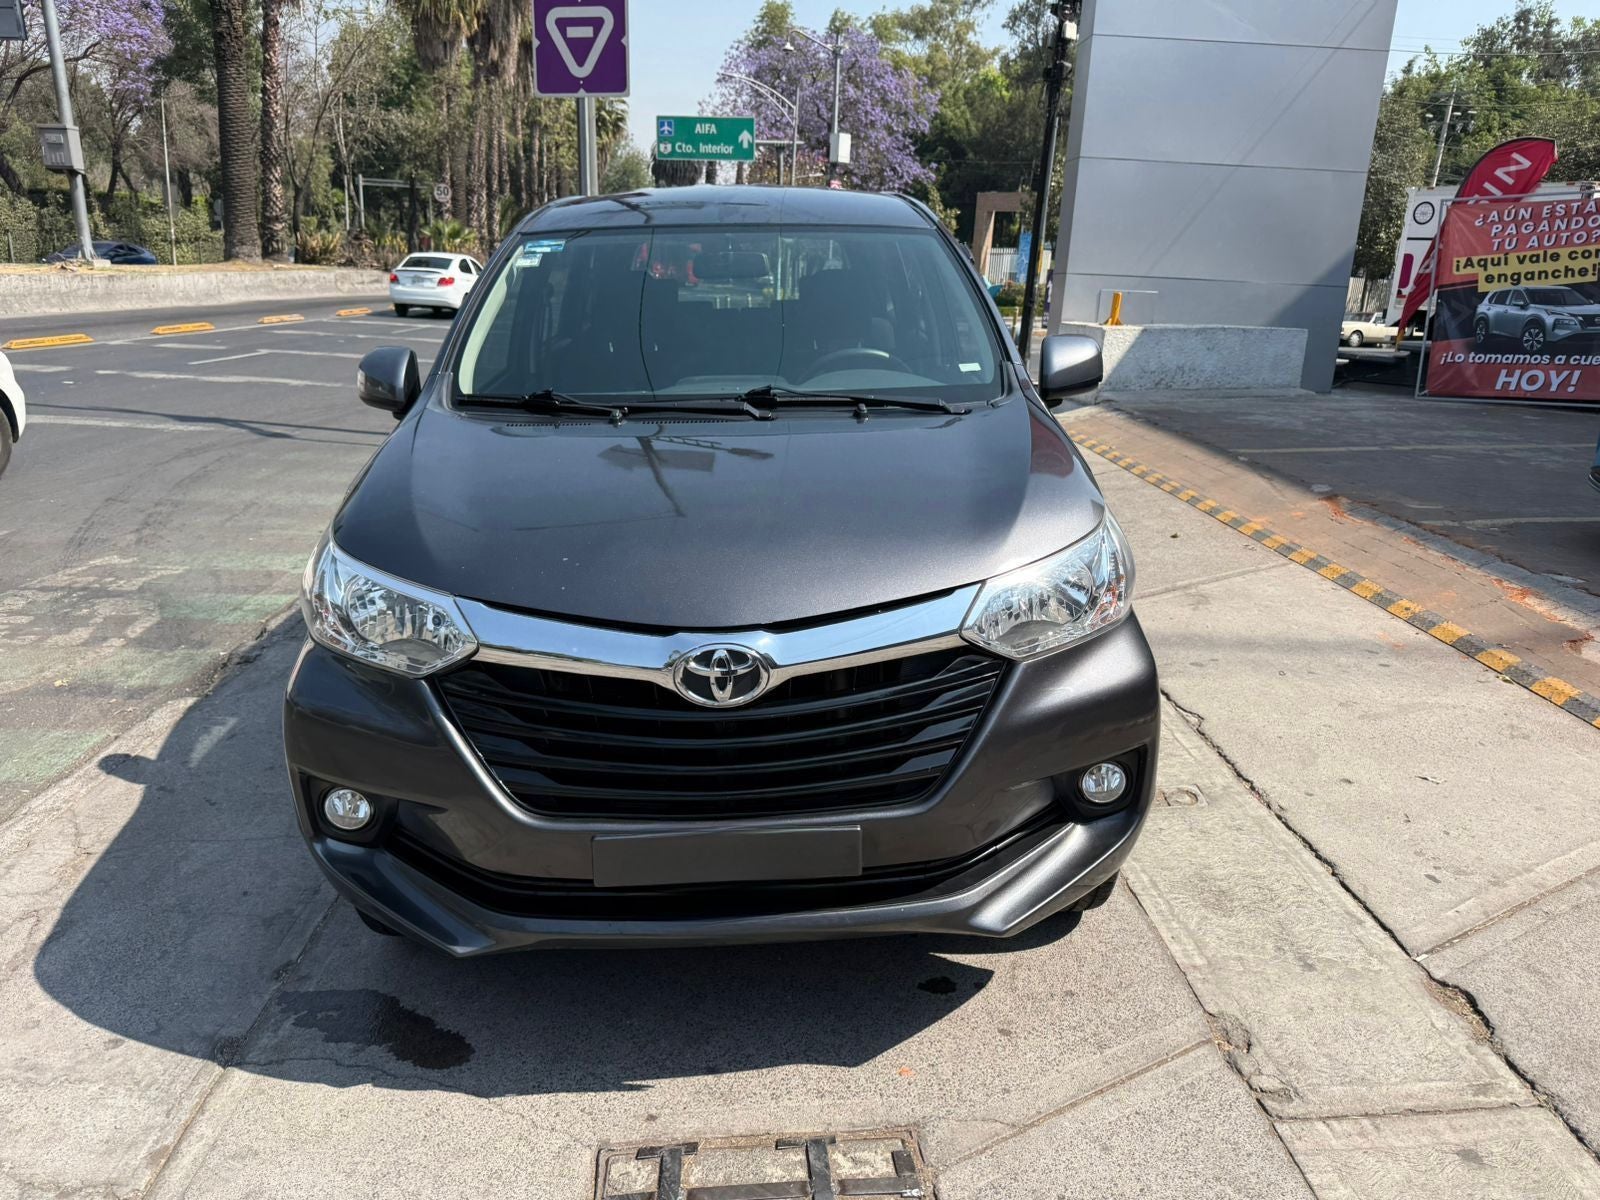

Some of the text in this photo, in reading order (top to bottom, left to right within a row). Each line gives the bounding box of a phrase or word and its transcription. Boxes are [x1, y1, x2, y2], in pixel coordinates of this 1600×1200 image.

[694, 123, 717, 134] AIFA
[675, 142, 696, 153] Cto.
[699, 143, 734, 154] Interior
[436, 186, 449, 196] 50
[1474, 205, 1533, 226] ¿AÚN
[1490, 214, 1600, 237] PAGANDO
[1491, 231, 1600, 251] TU AUTO?
[1455, 253, 1509, 272] ¡Aquí
[1516, 250, 1561, 265] vale
[1484, 264, 1597, 286] enganche!
[1440, 351, 1465, 365] ¡Lo
[1468, 351, 1550, 365] tomamos
[1554, 355, 1567, 365] a
[1495, 369, 1582, 393] HOY!
